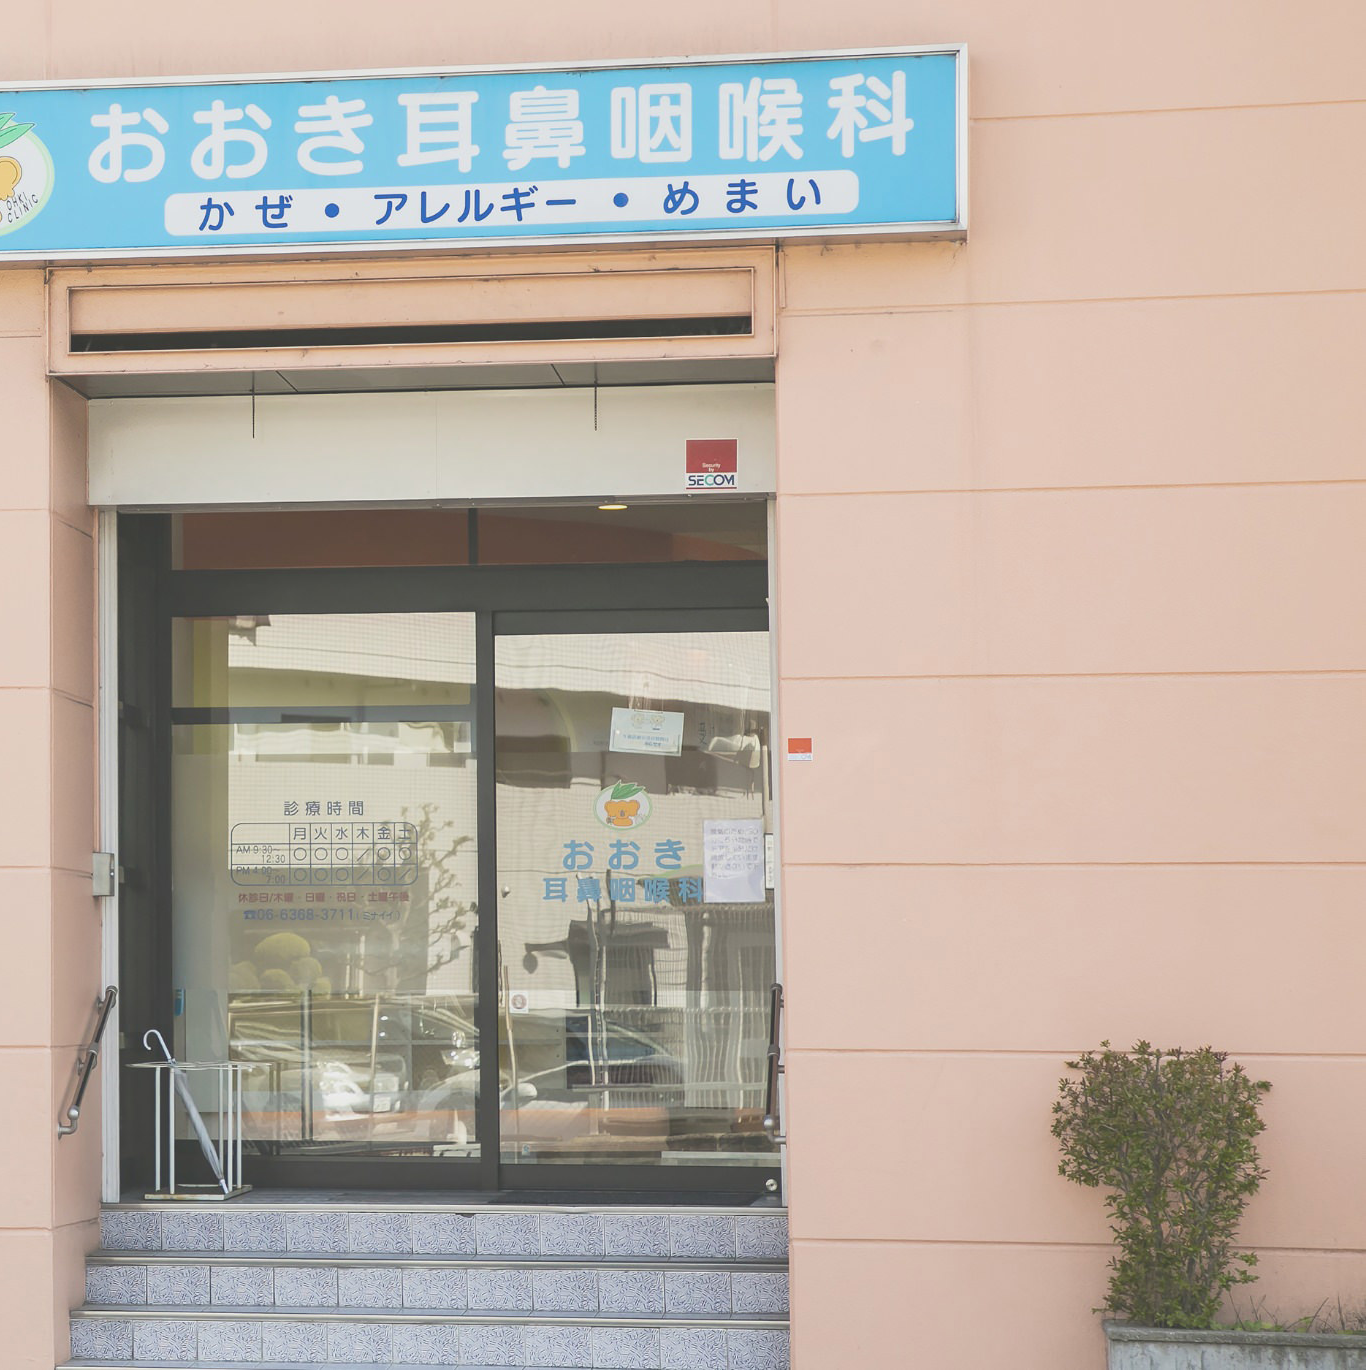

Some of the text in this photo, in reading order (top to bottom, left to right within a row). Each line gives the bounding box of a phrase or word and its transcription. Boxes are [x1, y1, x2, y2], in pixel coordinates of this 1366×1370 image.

[87, 69, 915, 184] おおき耳鼻咽喉科
[6, 191, 28, 211] OHKI
[7, 194, 39, 223] CLINIC
[688, 474, 735, 486] SECOM
[283, 801, 364, 816] 診療時間
[293, 827, 412, 840] 月 火 水 木 金 土
[236, 845, 251, 854] AM
[562, 839, 685, 870] おおき
[261, 854, 286, 864] 12:30
[236, 866, 250, 875] PM
[266, 875, 286, 884] 7:00
[542, 877, 703, 902] 耳鼻咽喉科
